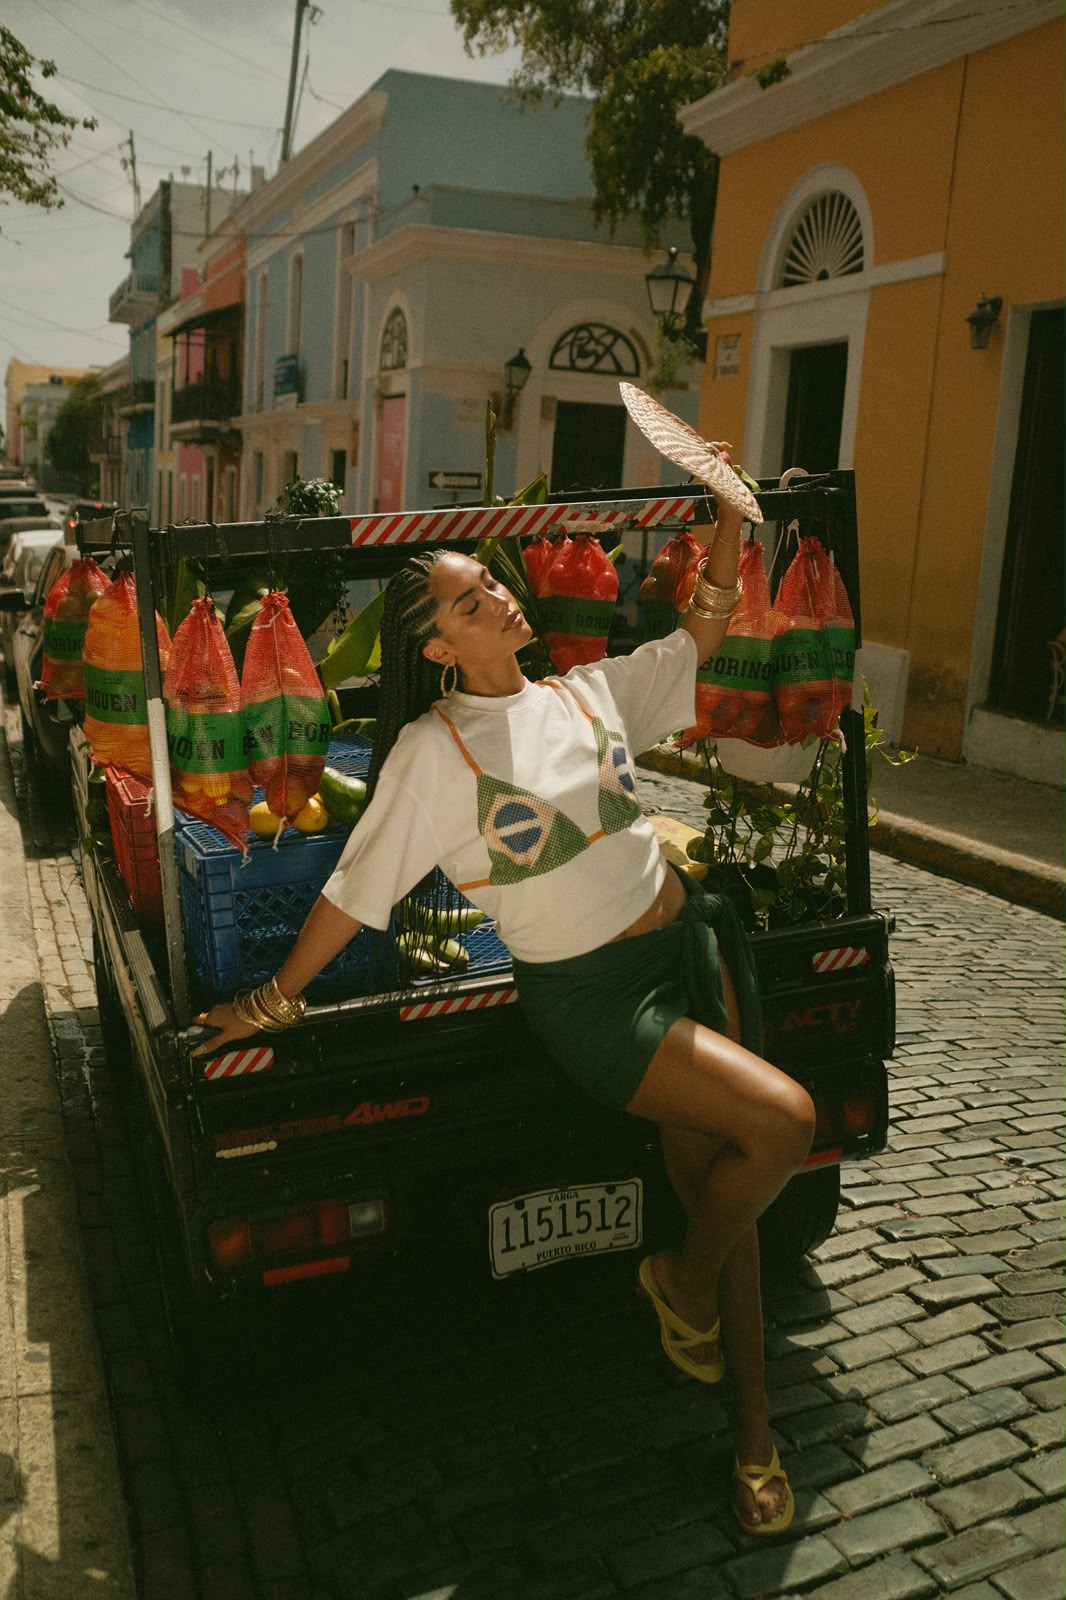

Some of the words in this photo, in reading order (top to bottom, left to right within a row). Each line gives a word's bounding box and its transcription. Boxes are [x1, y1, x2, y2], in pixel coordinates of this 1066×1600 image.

[783, 1000, 862, 1031] ACTY
[547, 1190, 579, 1204] CARGA
[500, 1195, 632, 1255] 1151512
[535, 1245, 573, 1263] PUERTO
[574, 1240, 598, 1253] RICO
